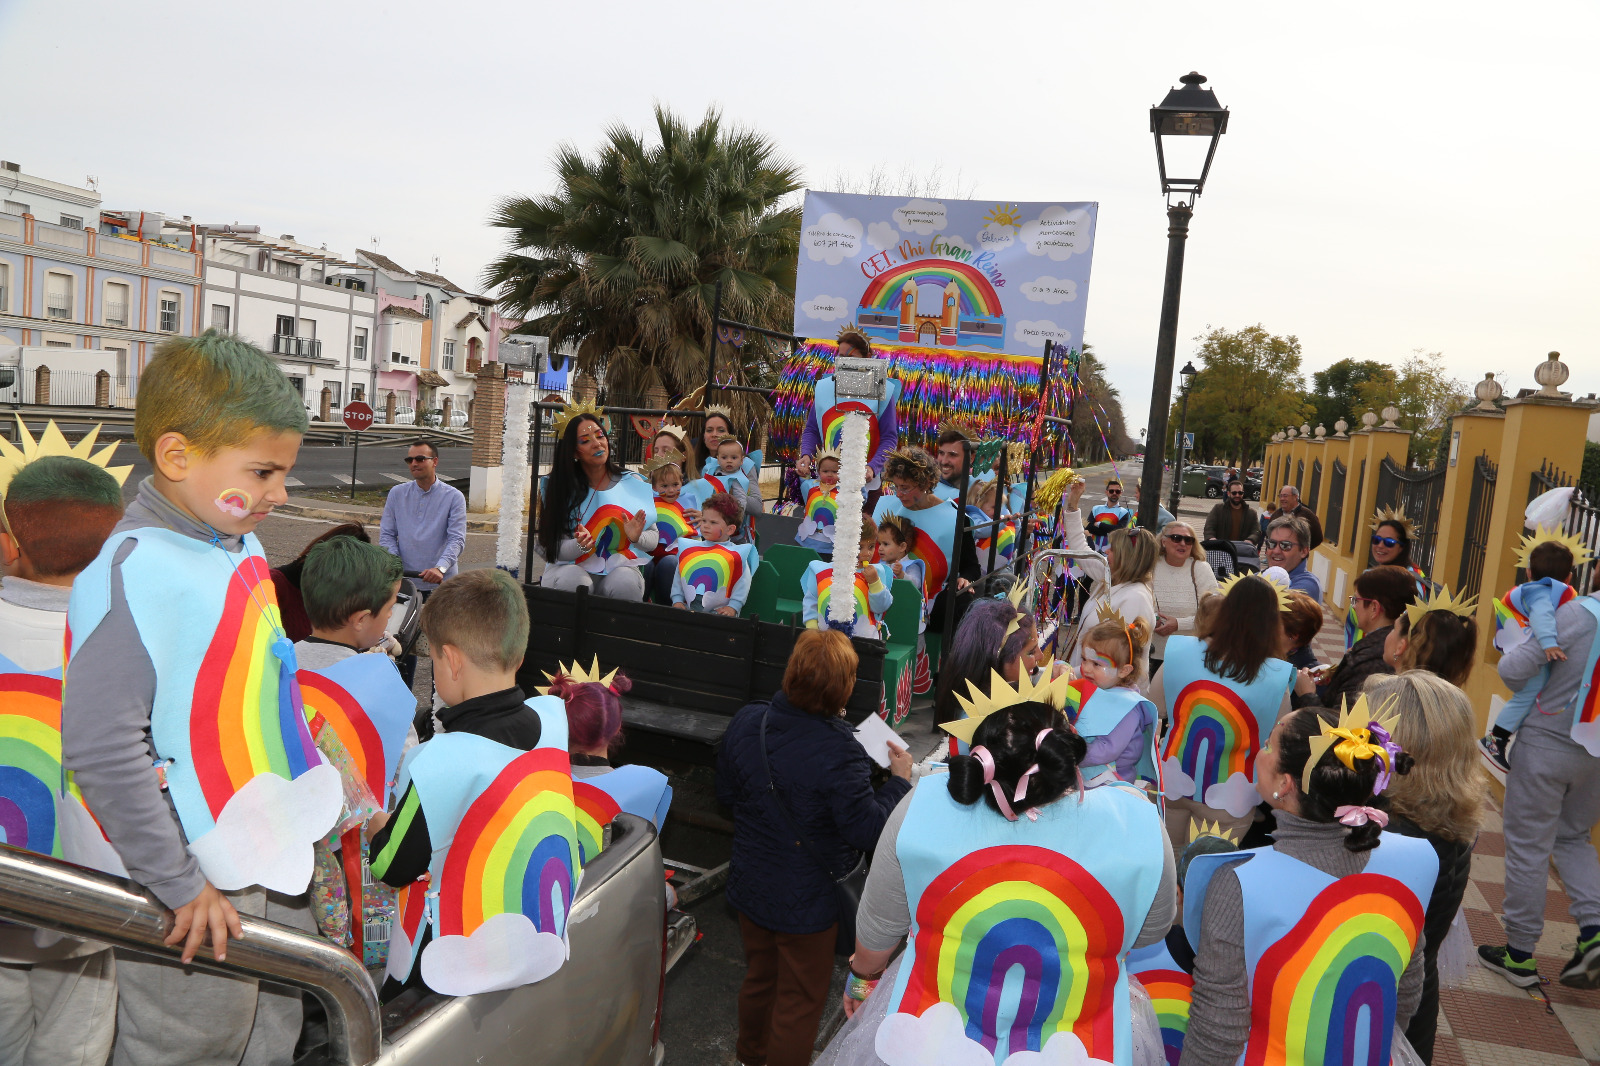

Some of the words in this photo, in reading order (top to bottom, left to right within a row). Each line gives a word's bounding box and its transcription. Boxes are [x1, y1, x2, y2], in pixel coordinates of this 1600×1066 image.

[899, 239, 925, 260] Mi
[930, 234, 973, 262] Gran
[972, 251, 1007, 288] Reino
[344, 410, 373, 421] STOP
